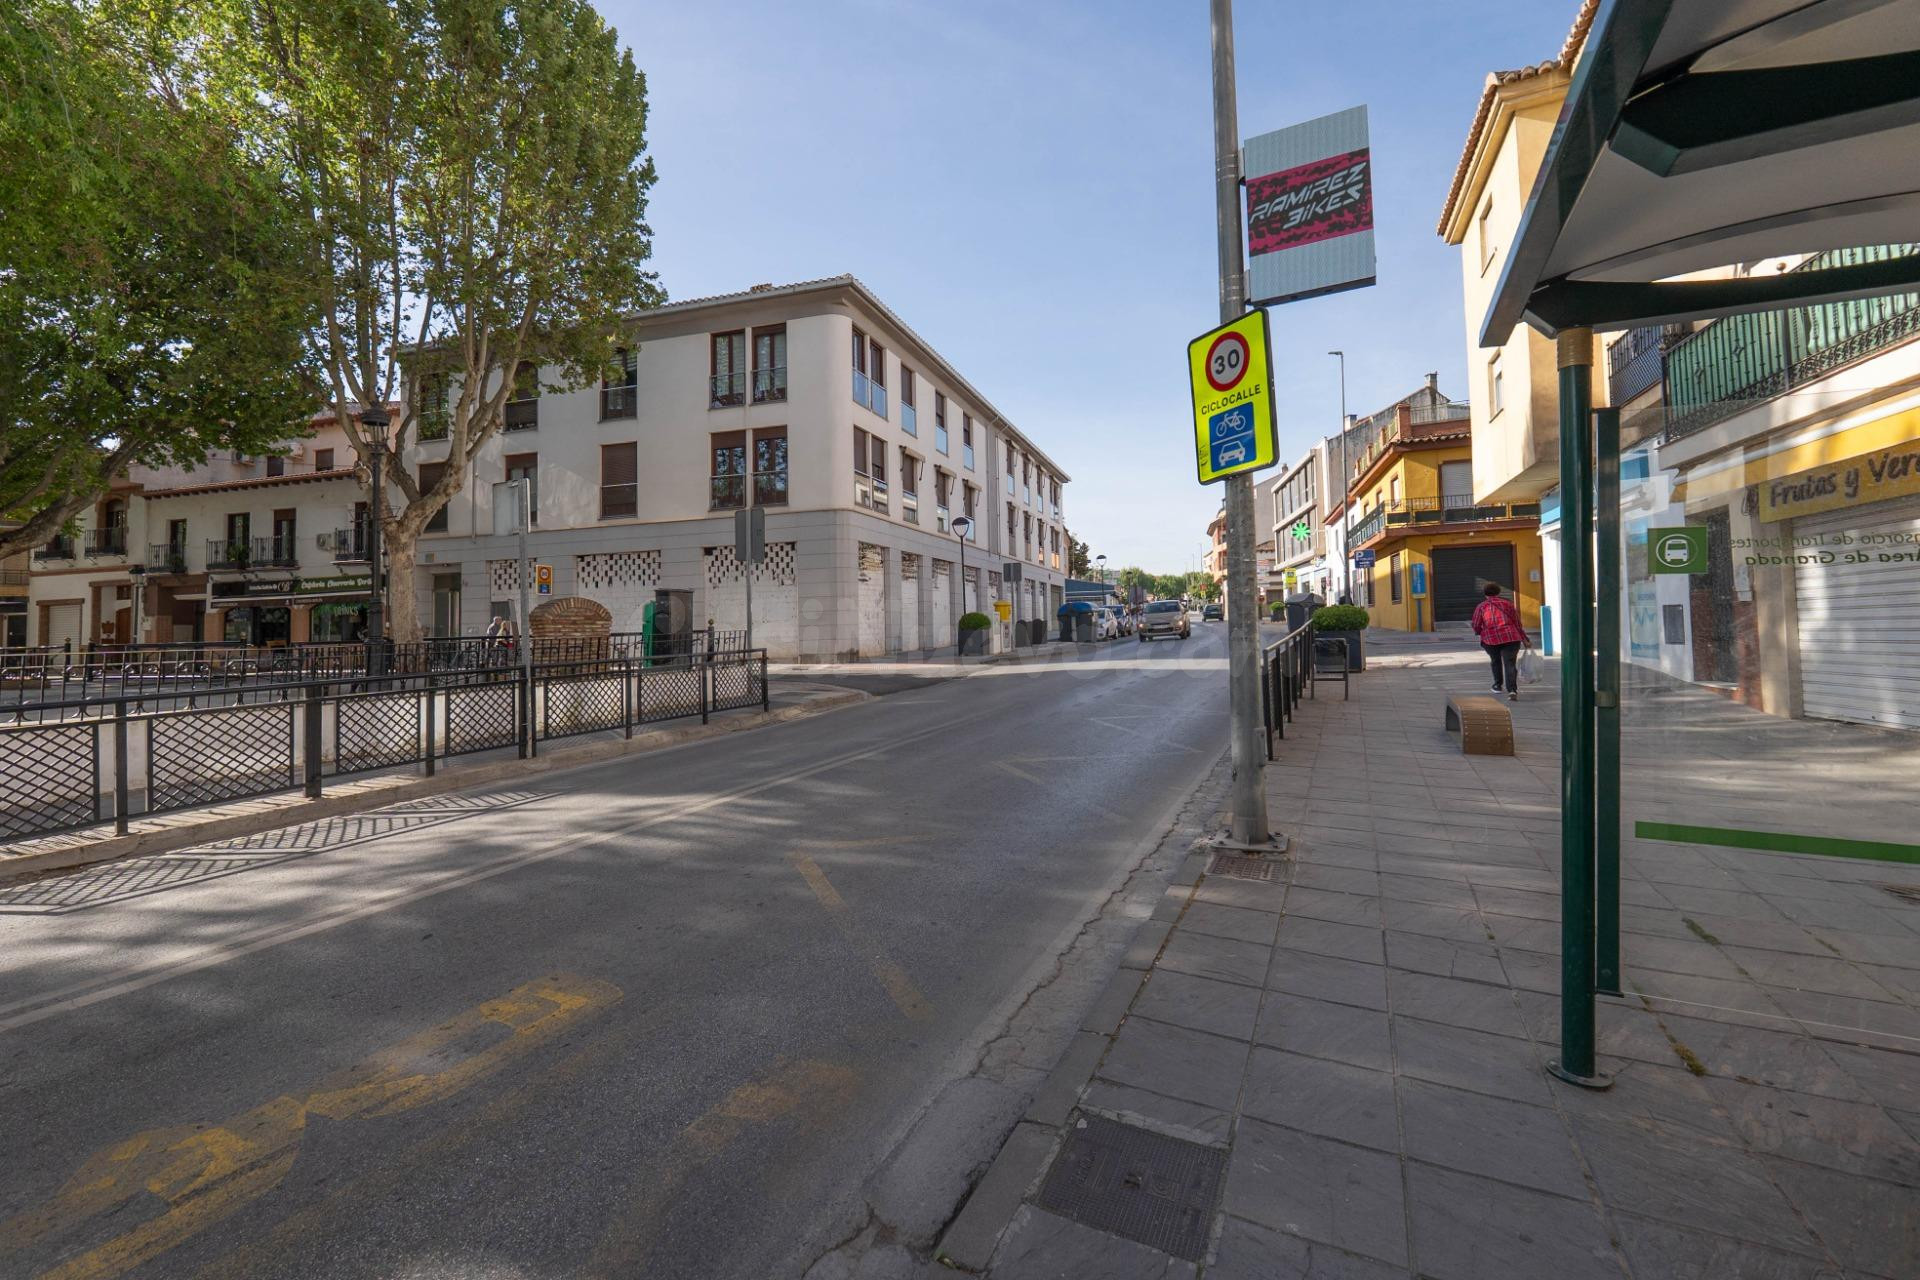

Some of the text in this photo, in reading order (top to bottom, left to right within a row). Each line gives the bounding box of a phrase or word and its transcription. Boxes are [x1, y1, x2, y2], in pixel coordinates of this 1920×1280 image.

[1214, 349, 1240, 375] 30
[1201, 384, 1262, 415] CICLOCALLE
[1770, 472, 1836, 507] Frutas
[1845, 467, 1860, 498] y
